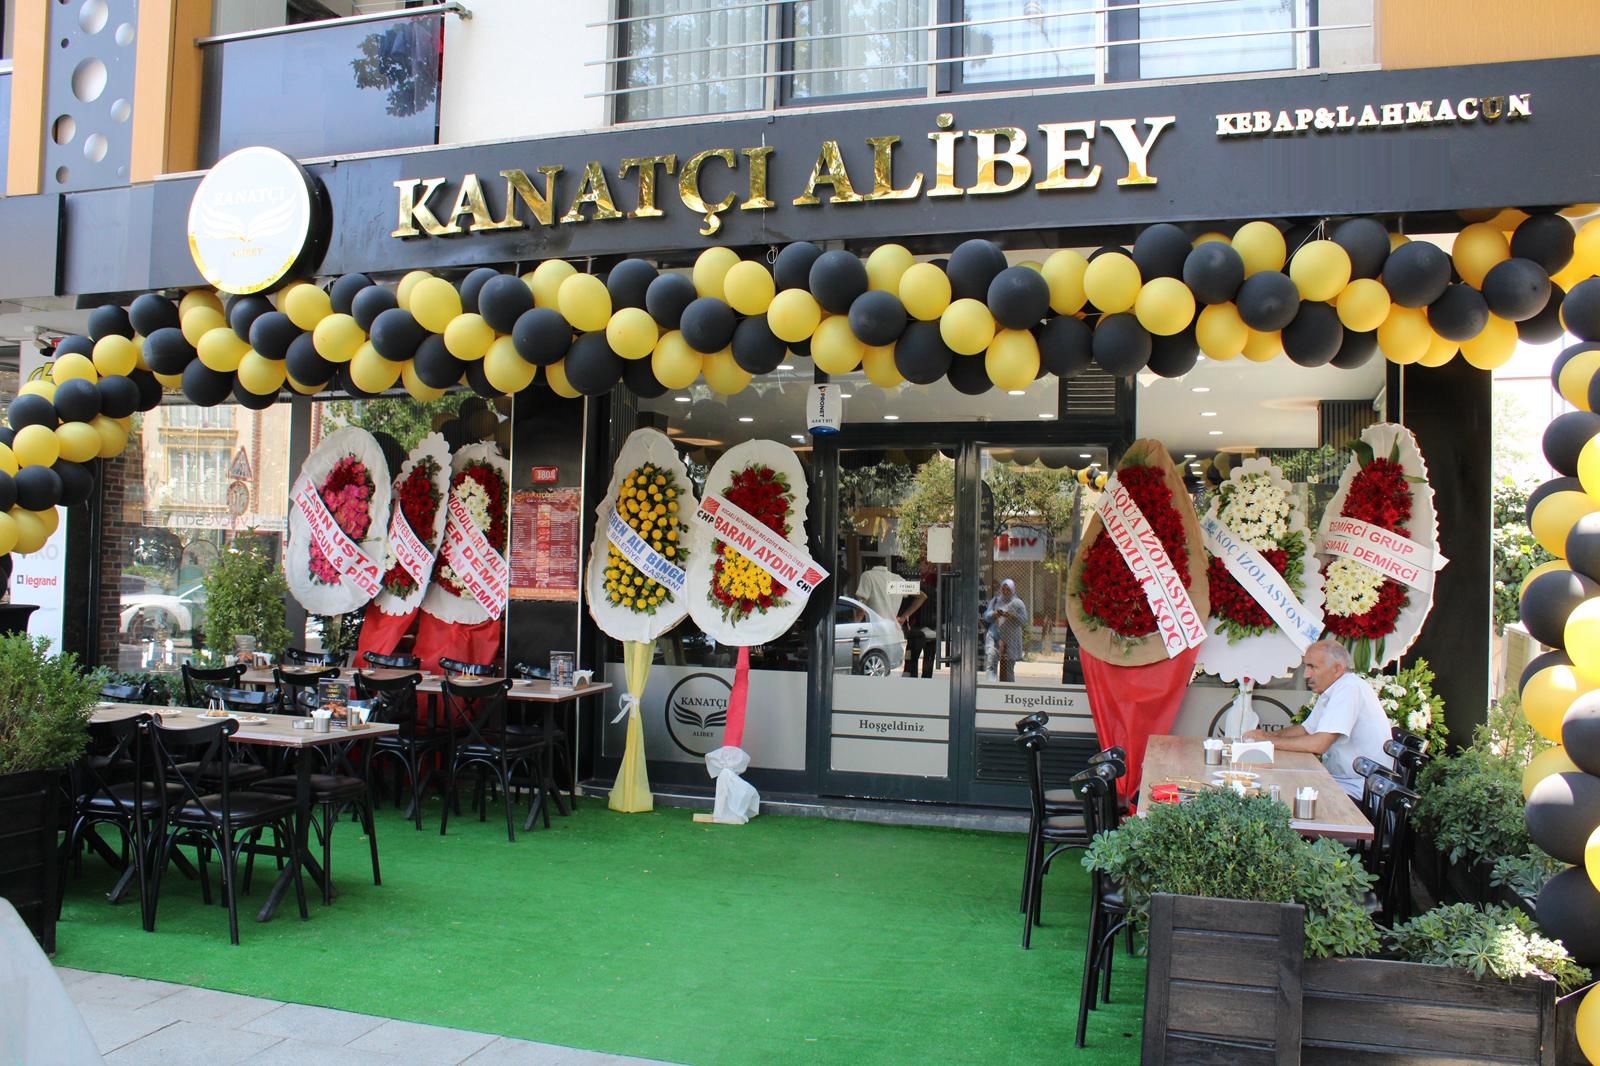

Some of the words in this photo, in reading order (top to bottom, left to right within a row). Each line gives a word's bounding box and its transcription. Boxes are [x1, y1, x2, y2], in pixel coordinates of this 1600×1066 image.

[1215, 93, 1532, 137] KEBAP&LAHMACUN
[391, 146, 775, 236] KANATÇI
[792, 112, 1176, 207] ALİBEY
[697, 510, 715, 524] CHP
[296, 492, 335, 556] LAHMACUN
[333, 556, 344, 568] &
[345, 566, 380, 596] PİDE
[333, 530, 379, 580] USTA
[714, 515, 757, 551] BARAN
[753, 546, 798, 581] AYDIN
[1108, 484, 1142, 528] AQUA
[1139, 528, 1204, 641] İZOLASYON
[1352, 545, 1420, 582] DEMİRCİ
[1369, 531, 1414, 555] GRUP
[25, 575, 57, 588] legrand
[462, 545, 507, 602] DEMİR
[462, 571, 501, 619] DEMİR
[1100, 503, 1155, 586] MAHMUT
[1151, 594, 1183, 651] KOÇ
[1215, 529, 1239, 558] KOÇ
[1235, 549, 1303, 631] İZOLASYON
[681, 697, 727, 709] KANATÇI
[1004, 693, 1075, 708] Hoşgeldiniz
[859, 719, 925, 733] Hoşgeldiniz
